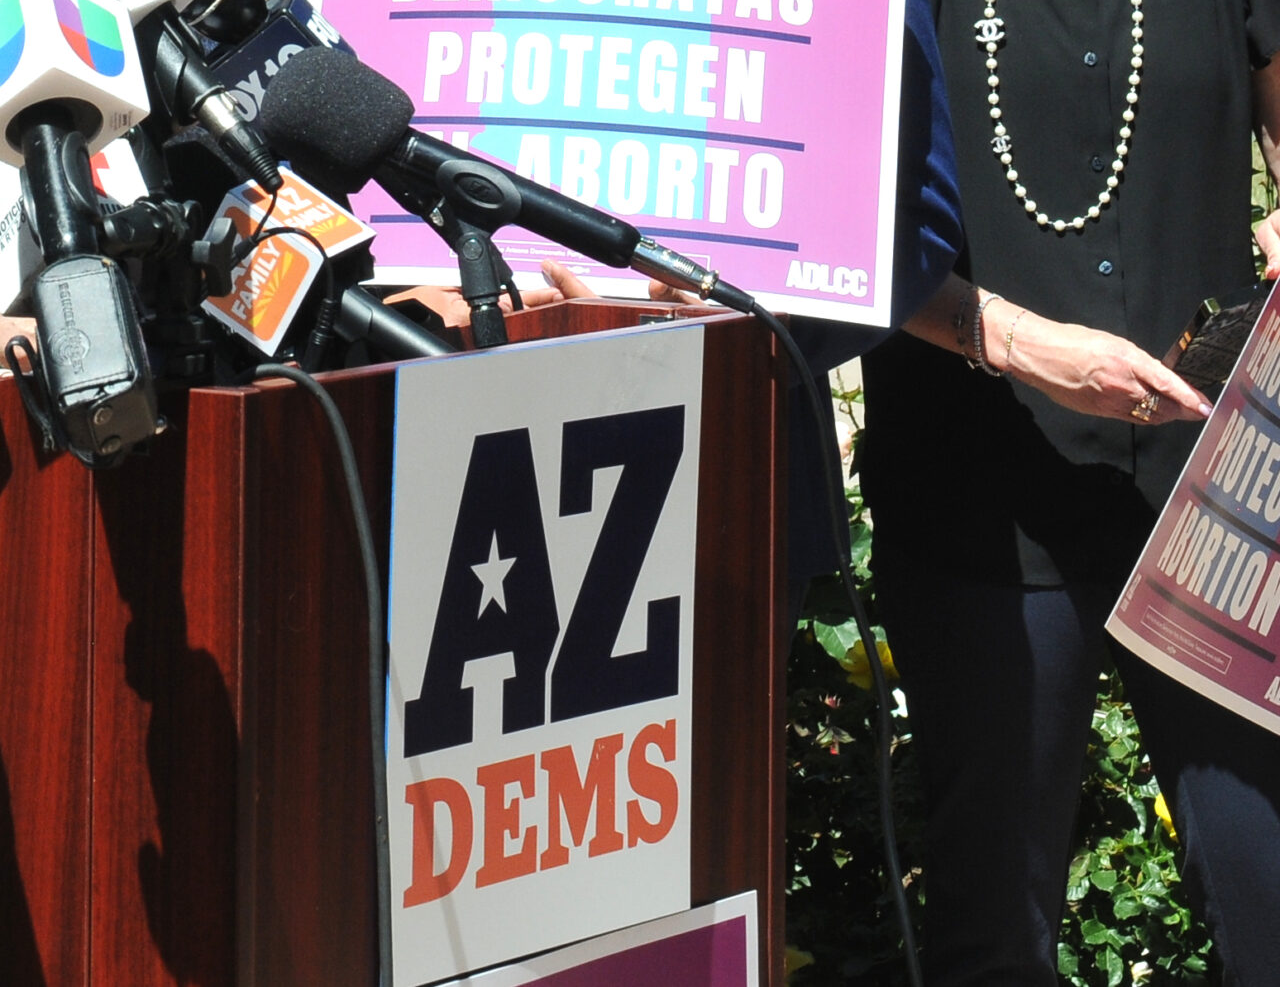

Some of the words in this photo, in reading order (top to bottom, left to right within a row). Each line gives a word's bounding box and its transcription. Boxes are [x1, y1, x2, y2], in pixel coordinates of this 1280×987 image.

[423, 31, 764, 124] PROTEGEN
[276, 187, 313, 215] AZ
[283, 202, 335, 229] FAMILY
[515, 133, 786, 229] ABORTO
[231, 240, 281, 320] FAMILY
[785, 259, 869, 298] ADLCC
[404, 404, 685, 758] AZ
[1157, 499, 1280, 638] ABORTION
[402, 719, 679, 908] DEMS
